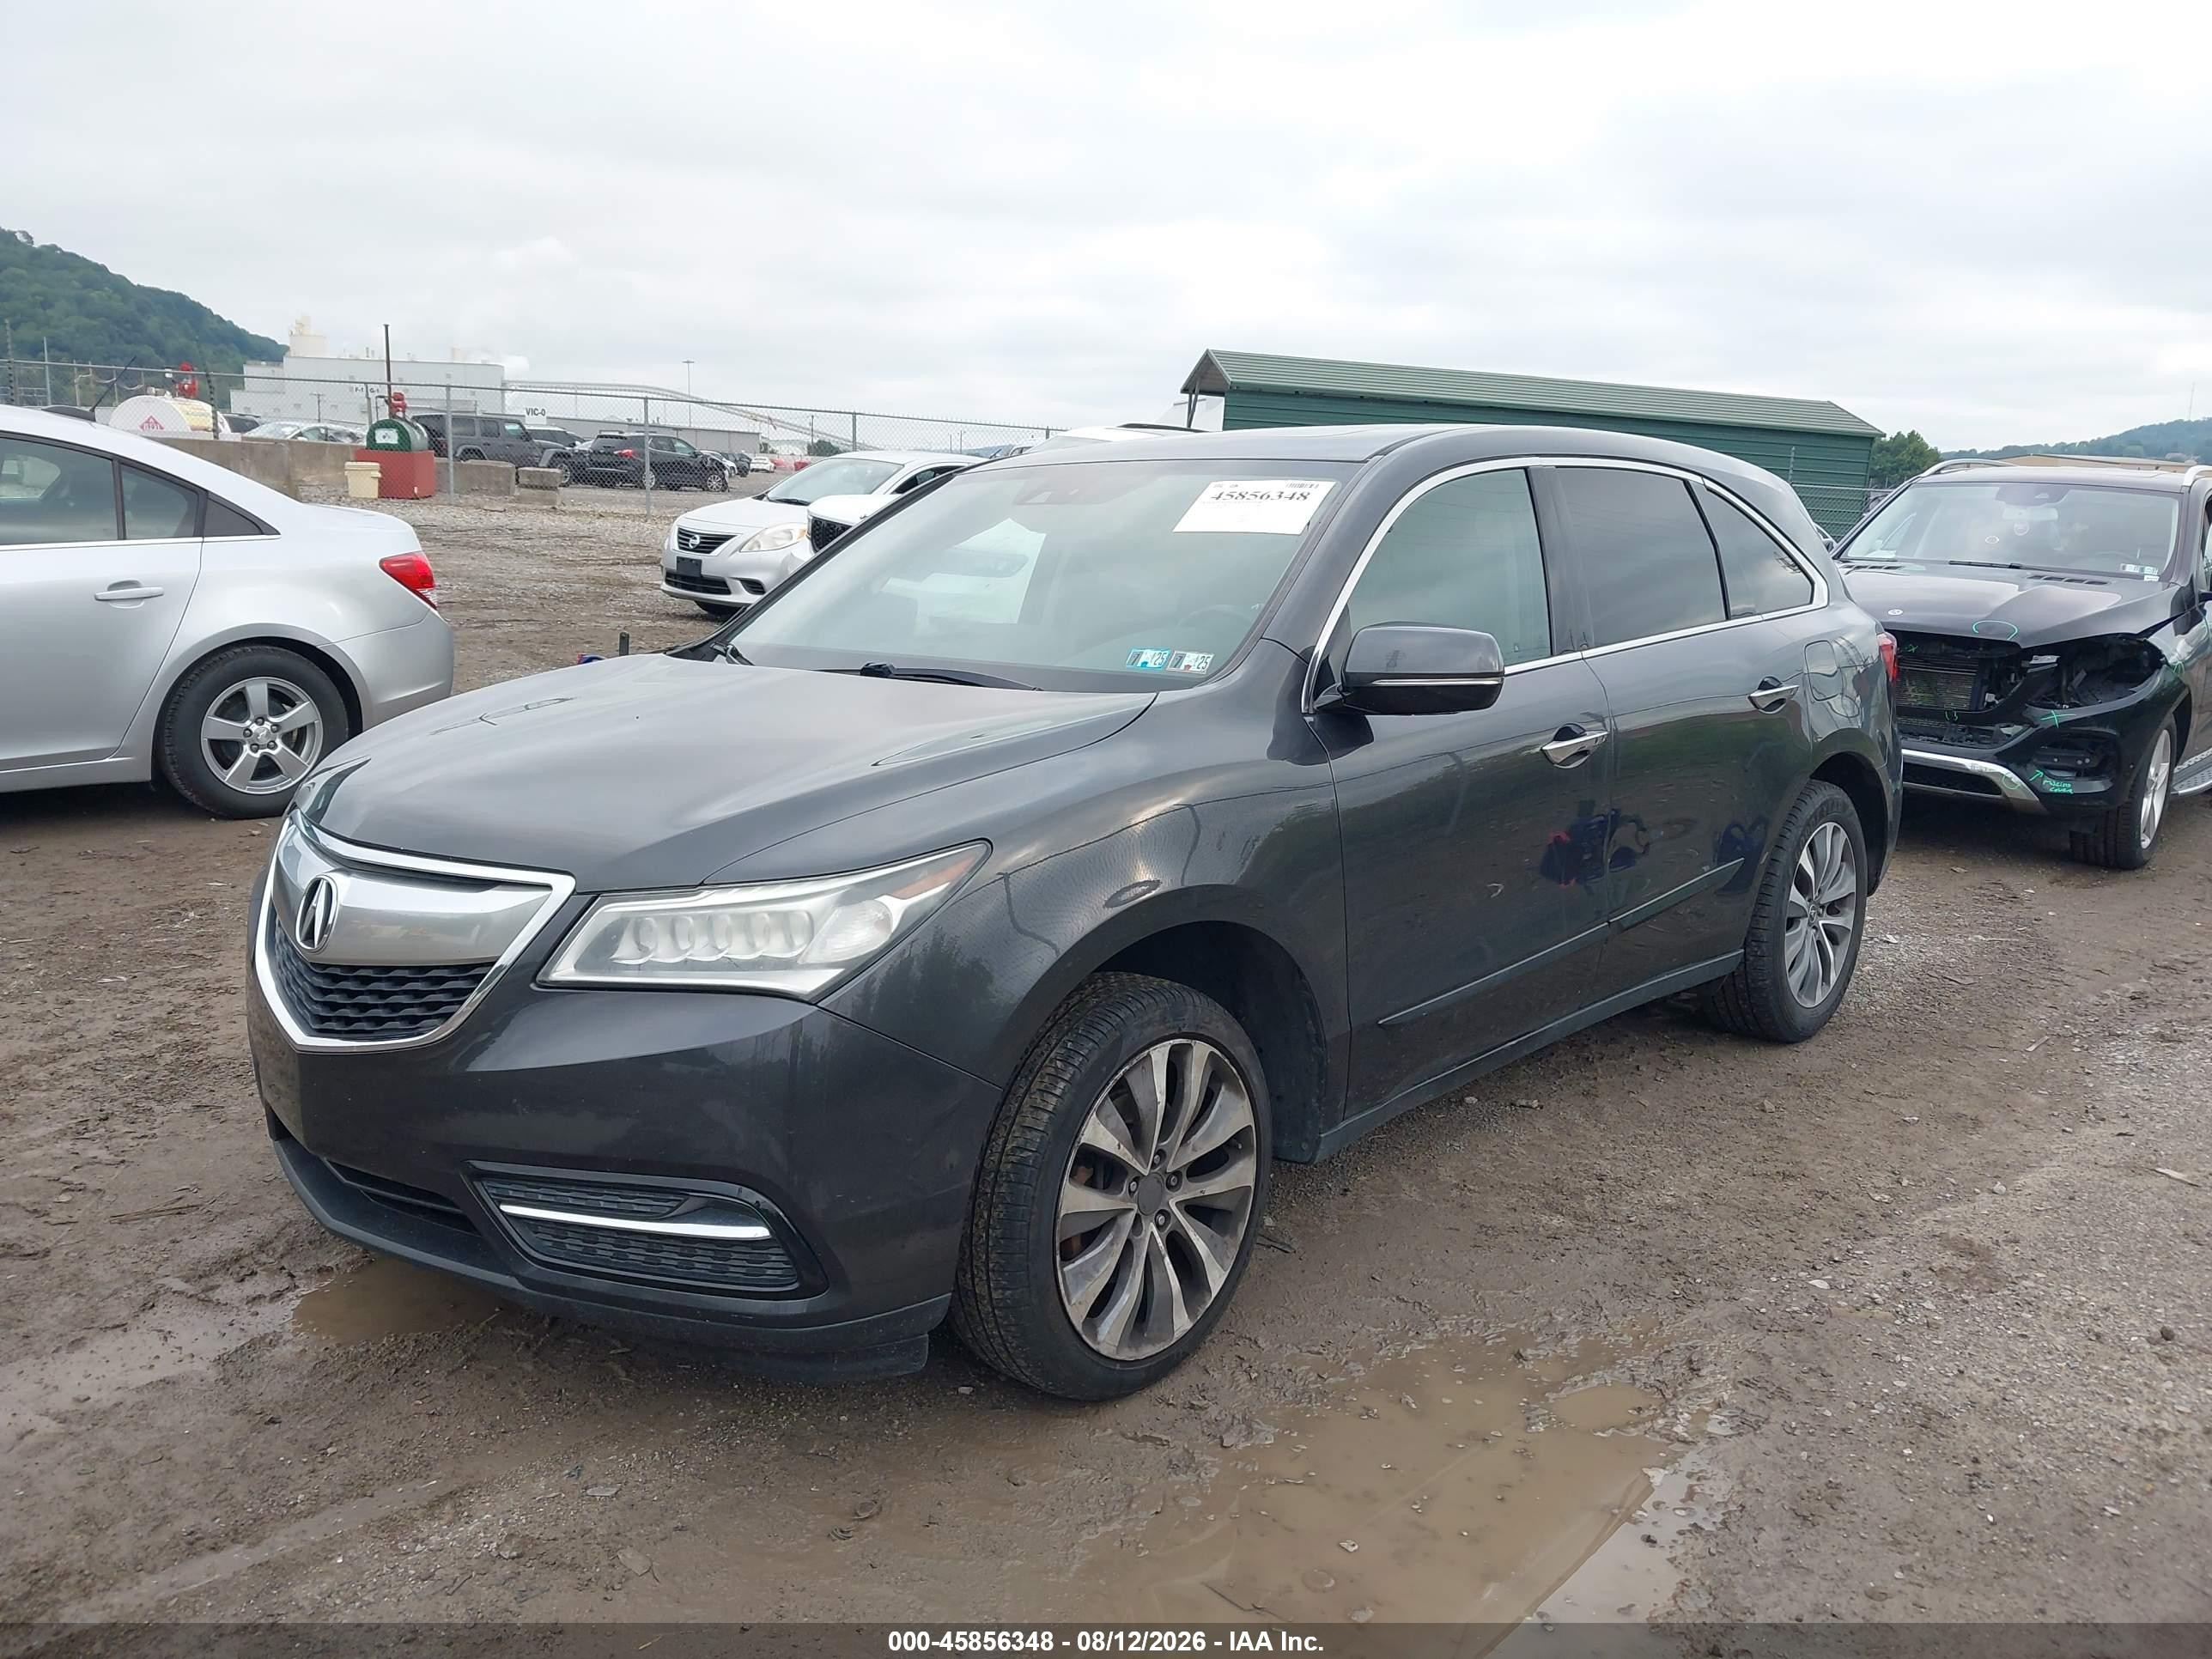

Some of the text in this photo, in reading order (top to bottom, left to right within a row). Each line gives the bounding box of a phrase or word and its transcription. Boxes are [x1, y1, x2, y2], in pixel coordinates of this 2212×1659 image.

[1211, 491, 1310, 501] 45856348
[1131, 653, 1167, 666] 7 25
[1174, 655, 1211, 670] 7 25
